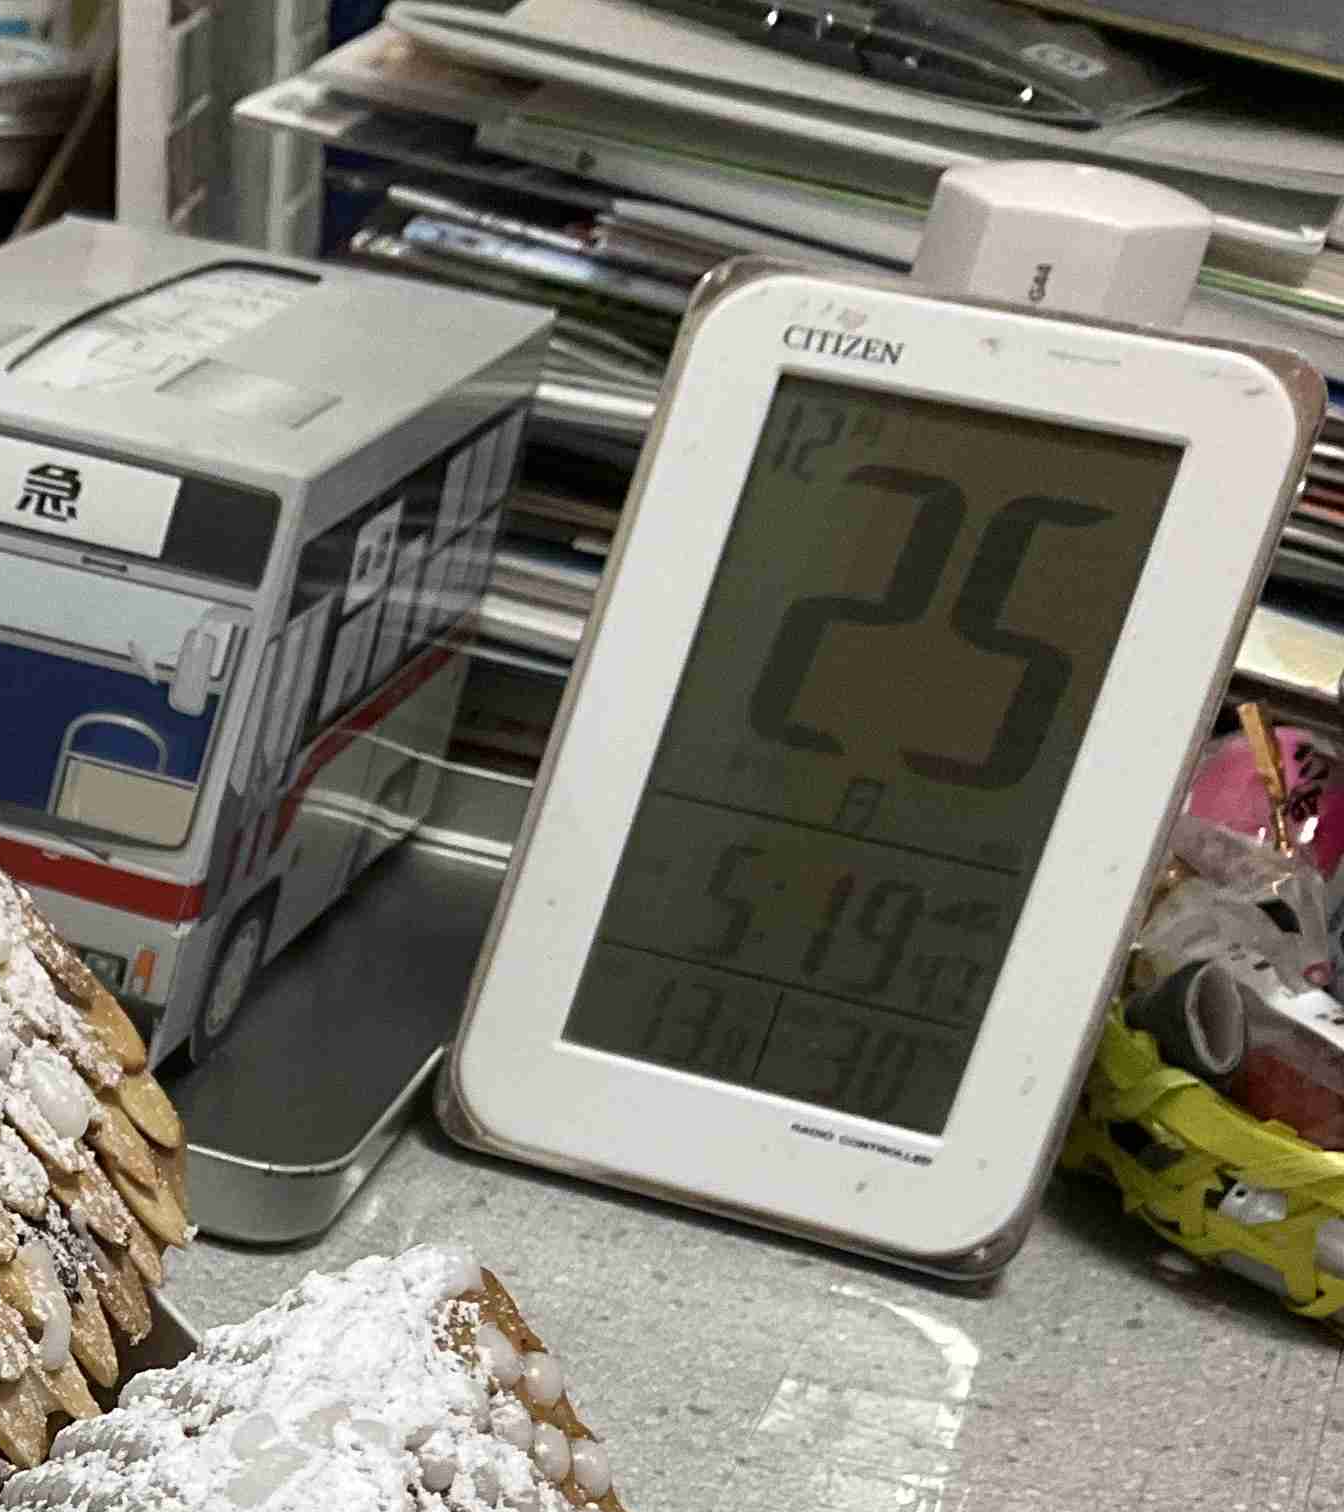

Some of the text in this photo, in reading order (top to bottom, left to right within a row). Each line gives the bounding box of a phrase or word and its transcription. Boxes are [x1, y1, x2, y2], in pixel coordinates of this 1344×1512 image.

[781, 323, 905, 366] CITIZEN
[747, 463, 1116, 790] 25
[790, 1123, 933, 1167] RADIO CONTROLLED
